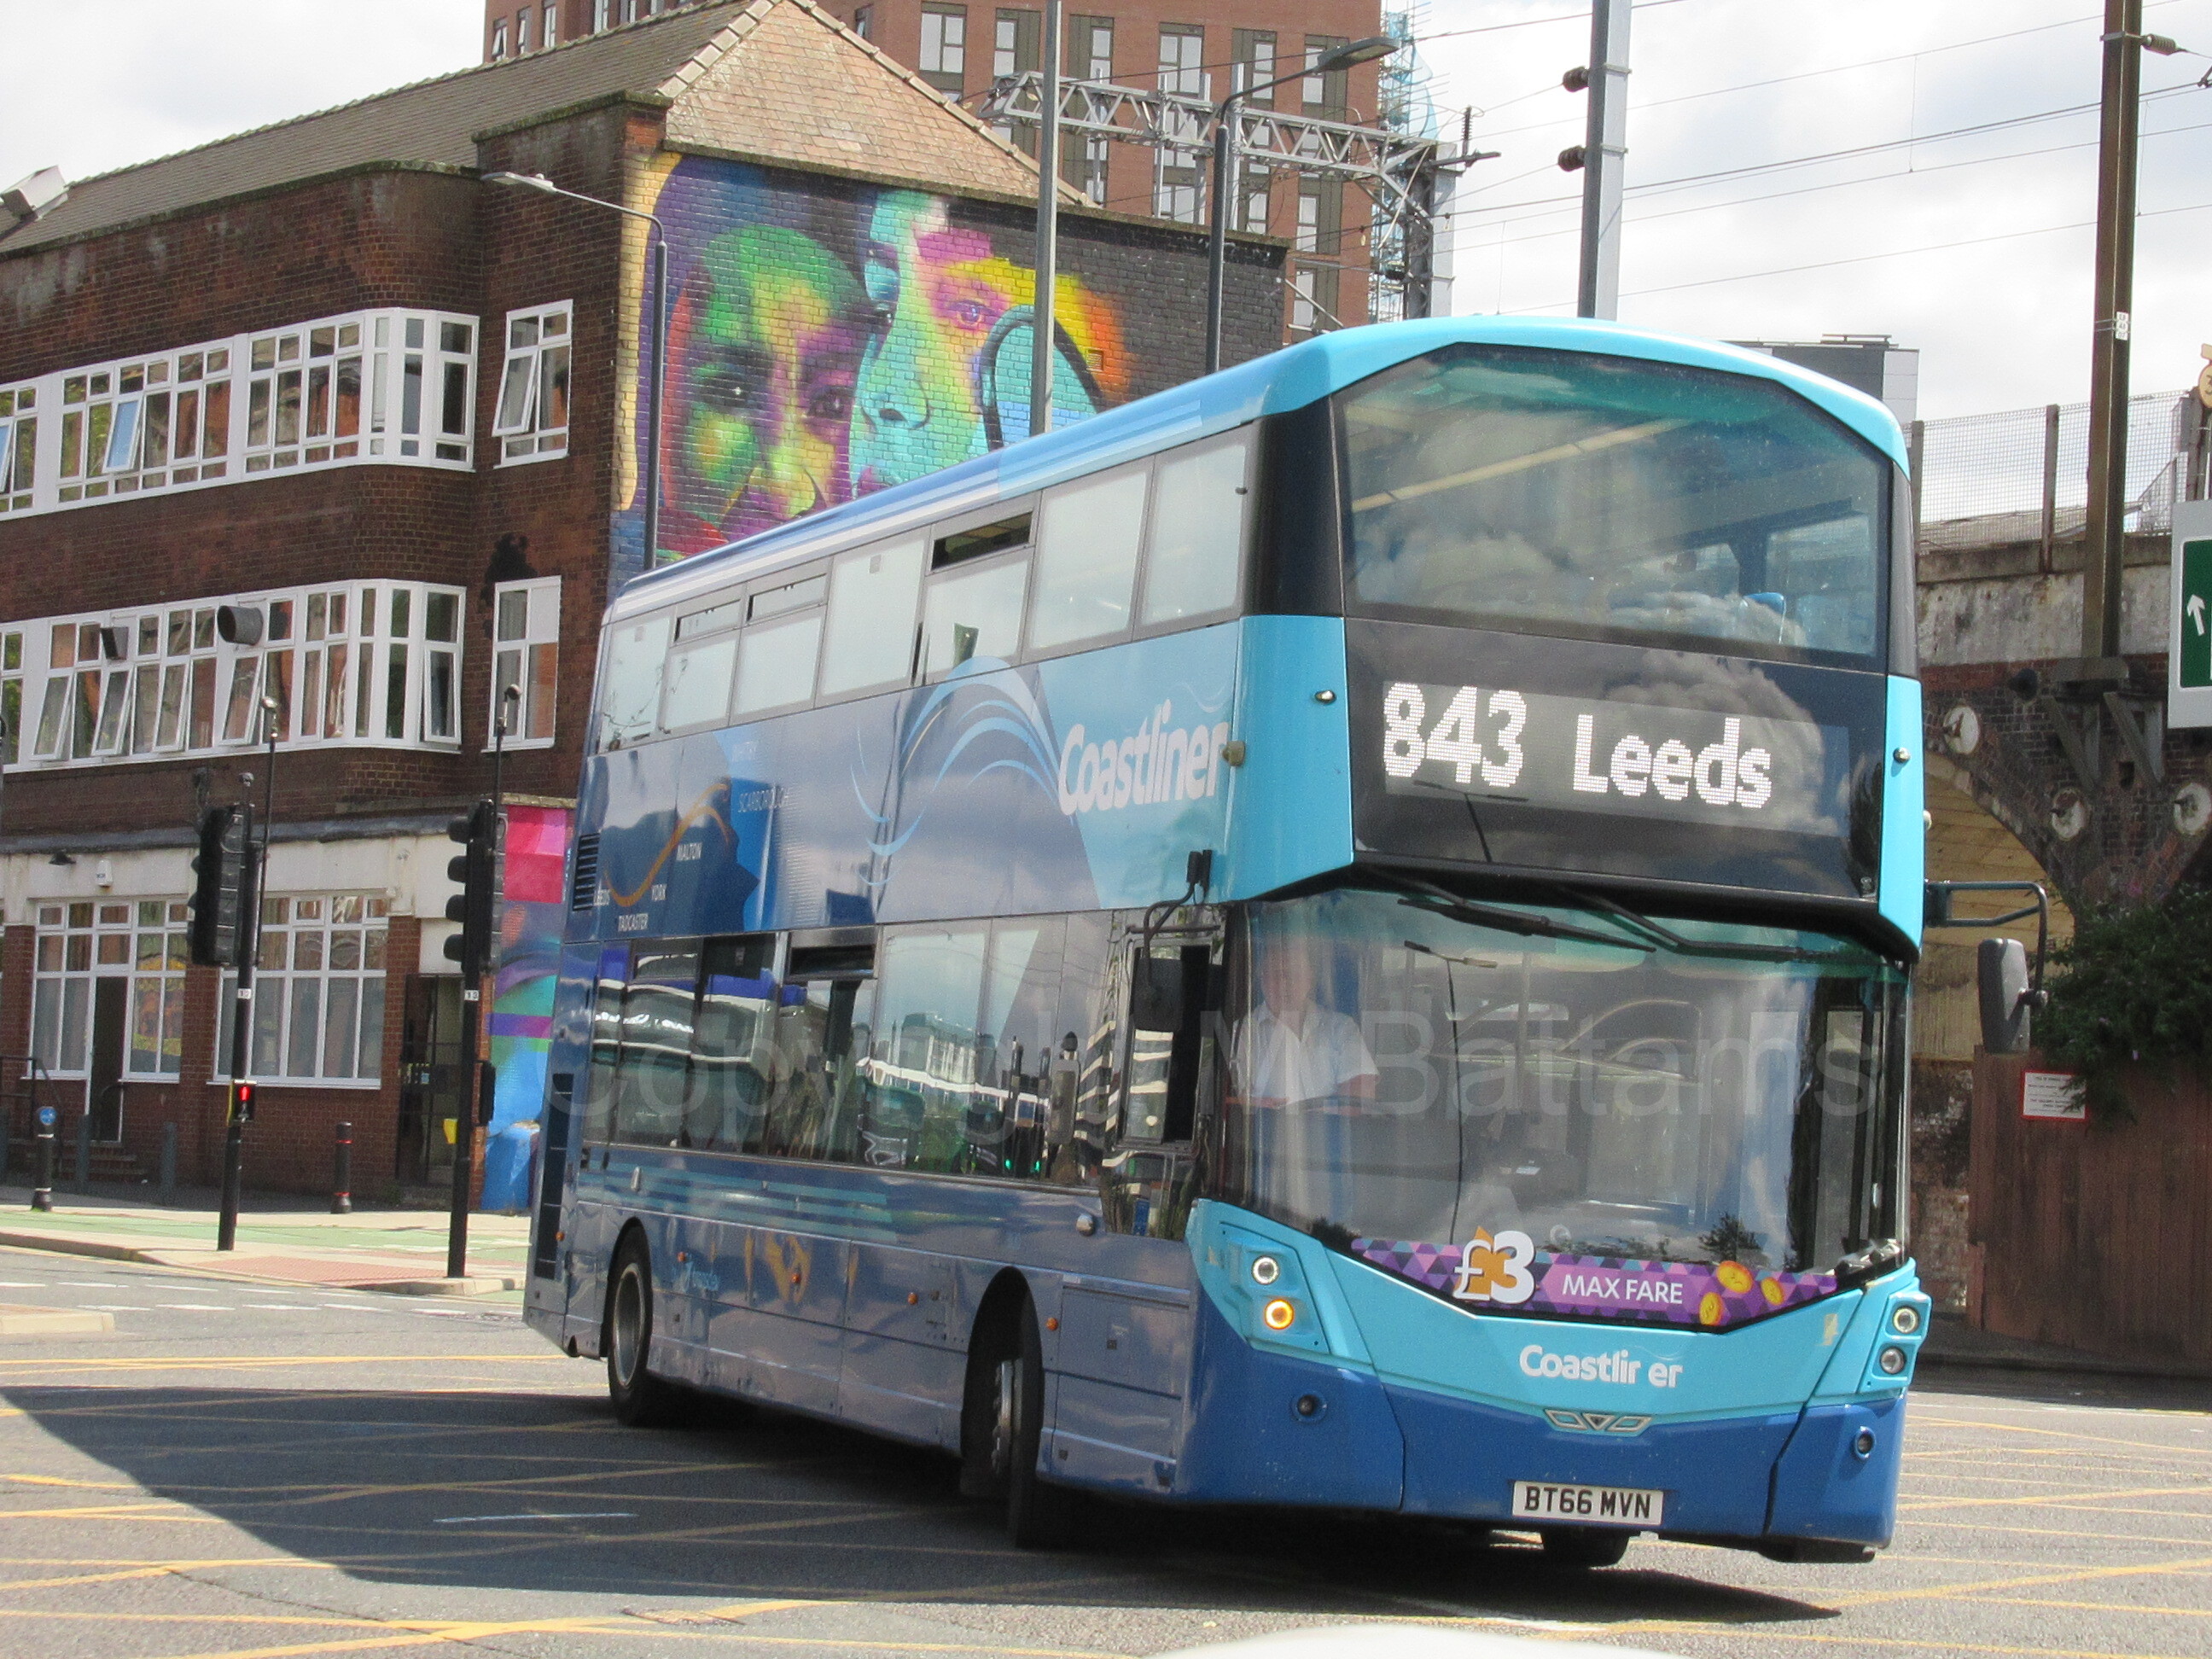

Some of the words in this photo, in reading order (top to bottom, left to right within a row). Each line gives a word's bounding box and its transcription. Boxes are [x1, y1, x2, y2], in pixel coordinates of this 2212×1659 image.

[1057, 699, 1229, 816] Coastliner
[1382, 682, 1528, 788] 843
[1573, 713, 1773, 809] Leeds
[1452, 1230, 1534, 1304] £3
[1562, 1274, 1621, 1300] MAX
[1625, 1278, 1685, 1305] FARE
[1524, 1486, 1593, 1515] BT66
[1599, 1490, 1652, 1519] MVN
